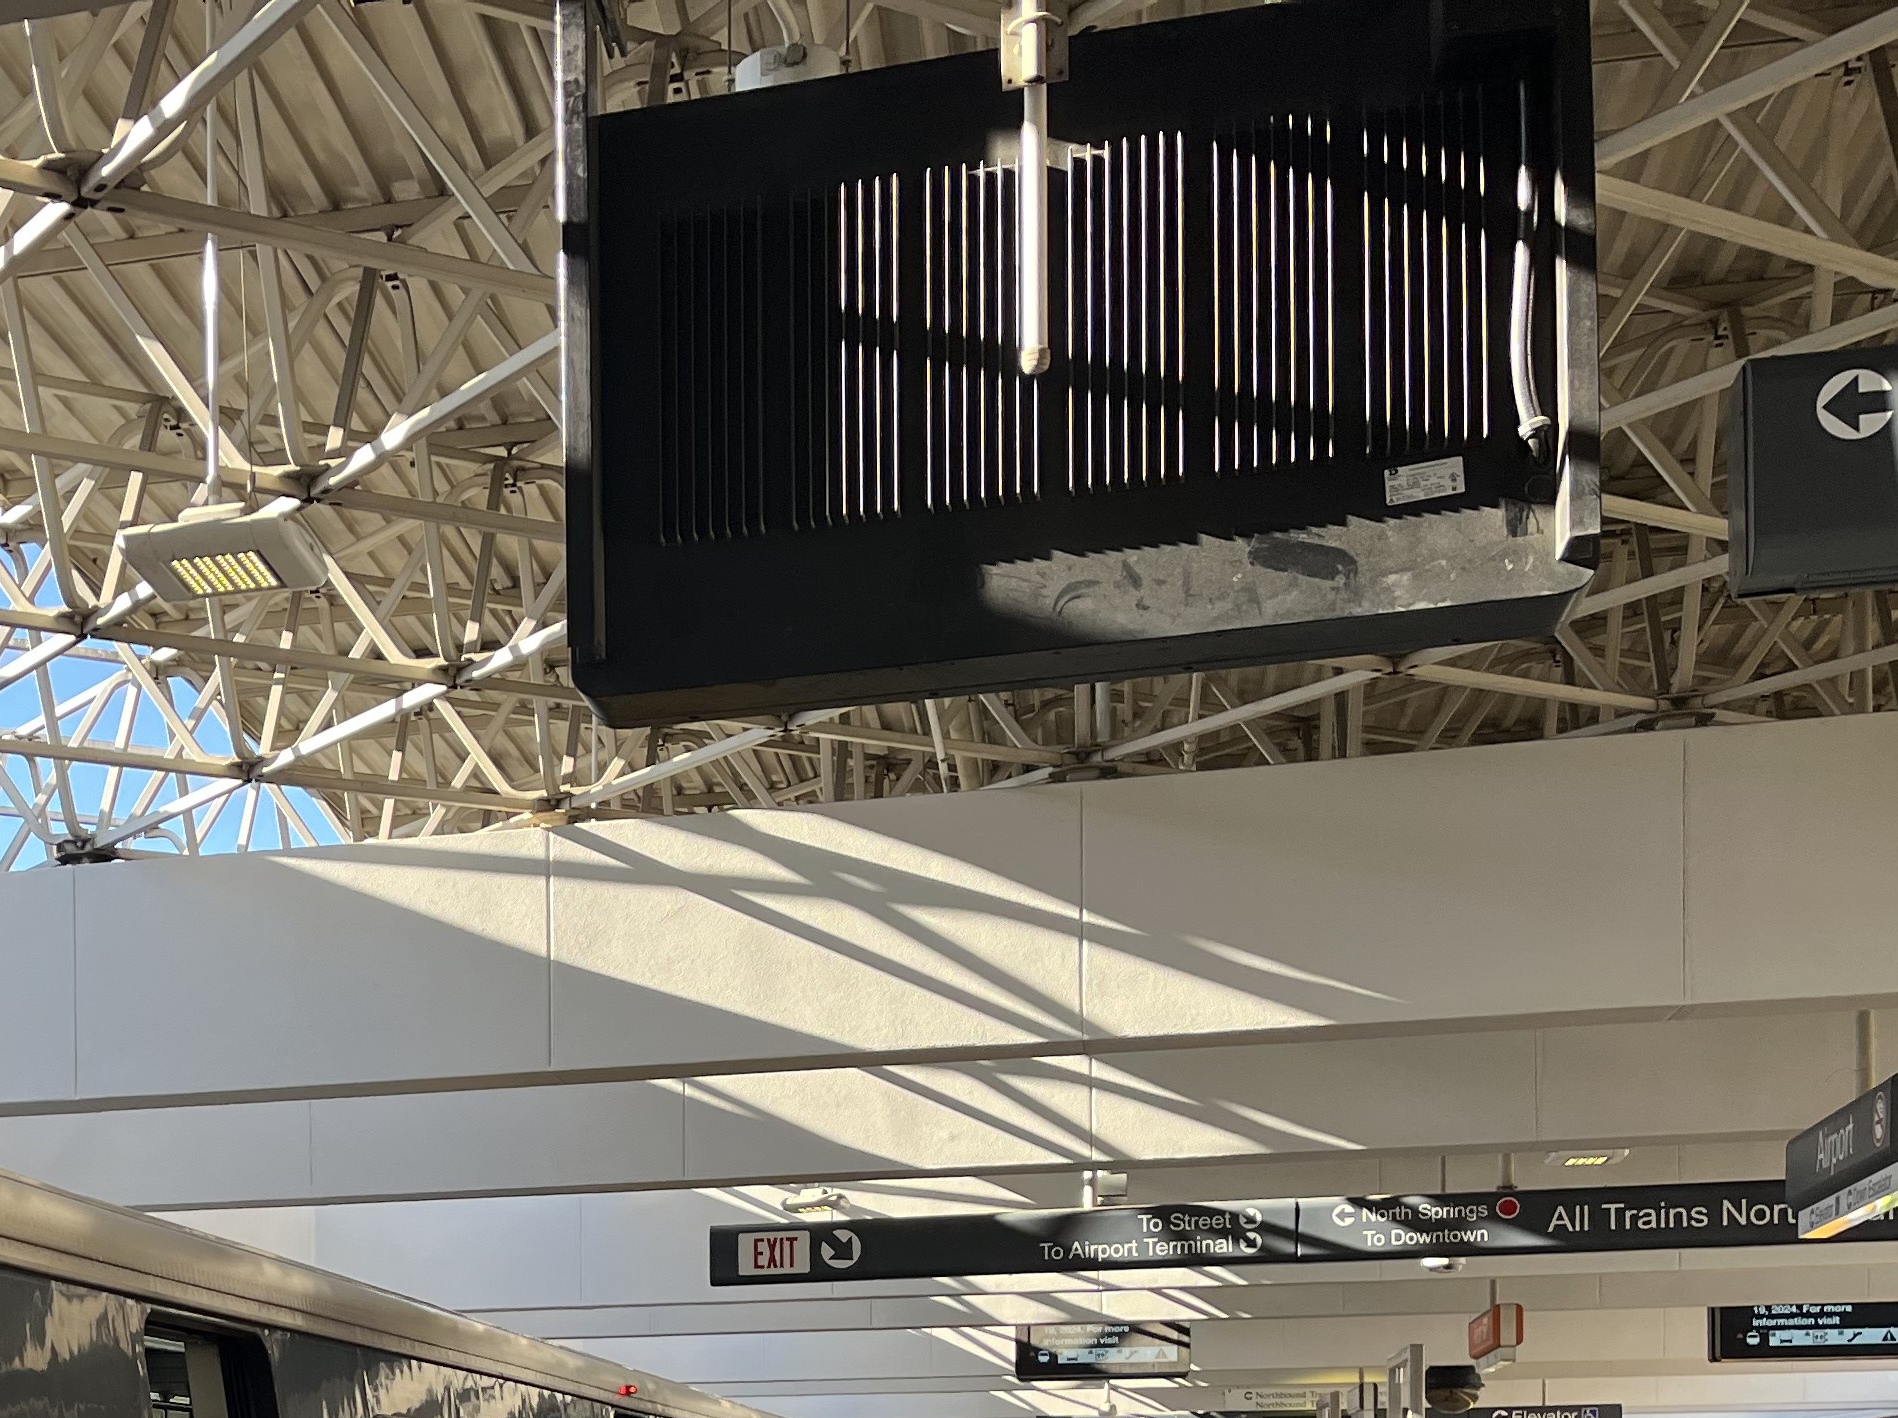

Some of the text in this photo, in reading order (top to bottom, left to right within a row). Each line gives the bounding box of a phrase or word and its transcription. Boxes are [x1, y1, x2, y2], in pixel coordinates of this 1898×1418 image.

[1816, 1114, 1855, 1176] Airport
[1138, 1211, 1232, 1233] To Street
[1362, 1203, 1489, 1223] North Springs
[1547, 1204, 1589, 1233] All
[1601, 1201, 1708, 1231] Trains
[1363, 1228, 1489, 1247] To Downtown
[753, 1236, 799, 1270] EXIT
[1039, 1235, 1233, 1262] To Airport Terminal
[1802, 1303, 1822, 1314] For
[1823, 1304, 1853, 1313] more
[1104, 1325, 1130, 1333] more
[1752, 1315, 1841, 1326] information visit
[1043, 1335, 1120, 1346] information visit
